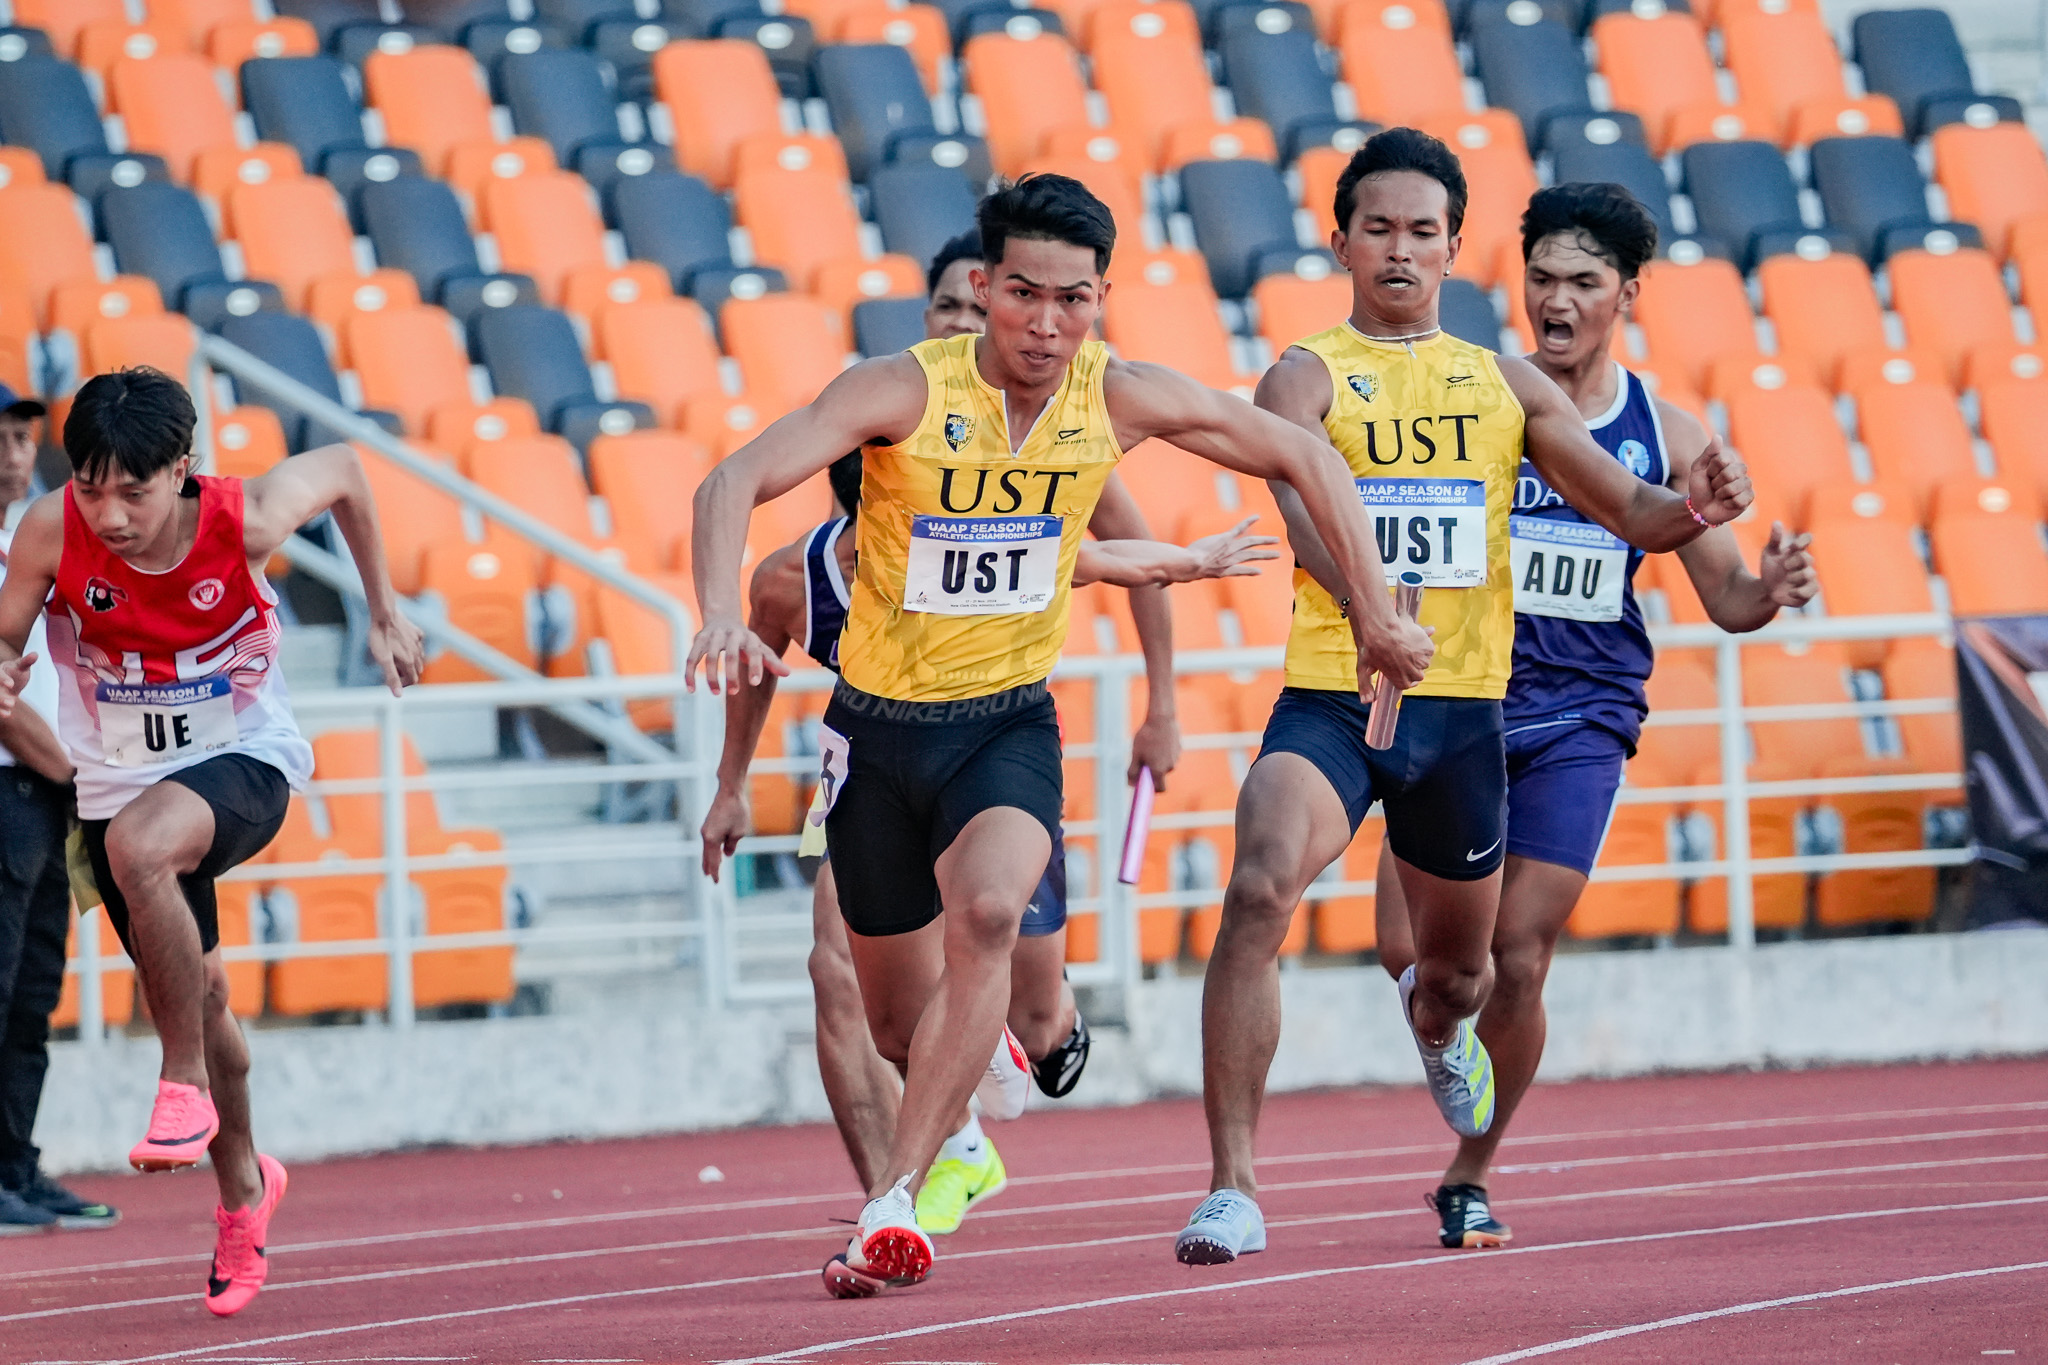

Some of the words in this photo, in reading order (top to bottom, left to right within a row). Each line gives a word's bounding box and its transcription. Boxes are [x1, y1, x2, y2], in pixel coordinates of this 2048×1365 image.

[1361, 414, 1479, 465] UST
[938, 467, 1078, 515] UST
[1357, 485, 1396, 496] UAAP
[1399, 485, 1452, 496] SEASON
[1454, 485, 1468, 496] 87
[1405, 496, 1467, 504] CHAMPIONSHIPS
[928, 521, 967, 533] UAAP
[970, 522, 1027, 533] SEASON
[1029, 521, 1046, 532] 87
[928, 531, 974, 540] ATHLETICS
[975, 531, 1043, 540] CHAMPIONSHIPS
[1375, 516, 1458, 565] UST
[941, 548, 1029, 595] UST
[1522, 551, 1602, 600] ADU
[837, 682, 873, 712] RO
[871, 698, 948, 723] NIKE
[946, 690, 1012, 722] PRO
[143, 712, 192, 752] UE
